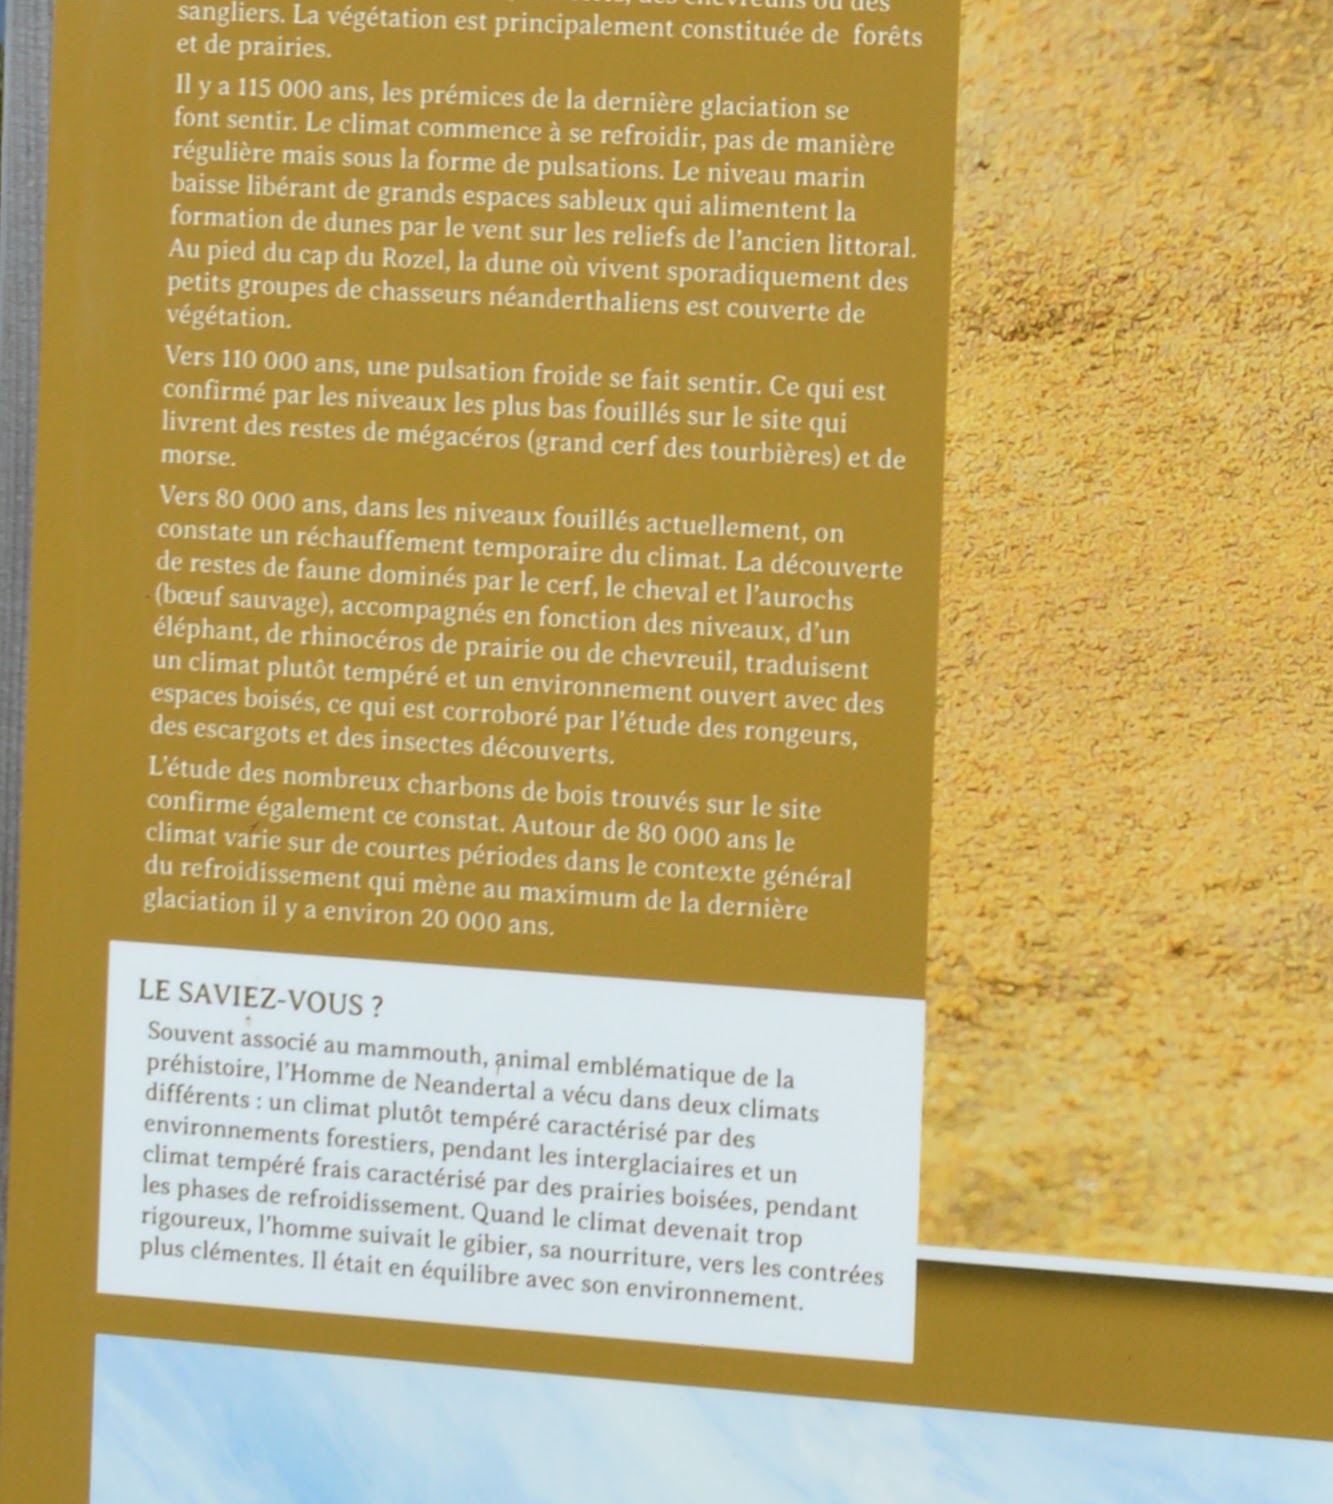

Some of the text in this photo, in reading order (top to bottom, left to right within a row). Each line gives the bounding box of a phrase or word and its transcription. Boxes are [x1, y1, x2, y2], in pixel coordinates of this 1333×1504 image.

[166, 303, 291, 330] végétation.
[161, 448, 236, 467] morse.
[139, 978, 383, 1017] LE SAVIEZ-VOUS ?
